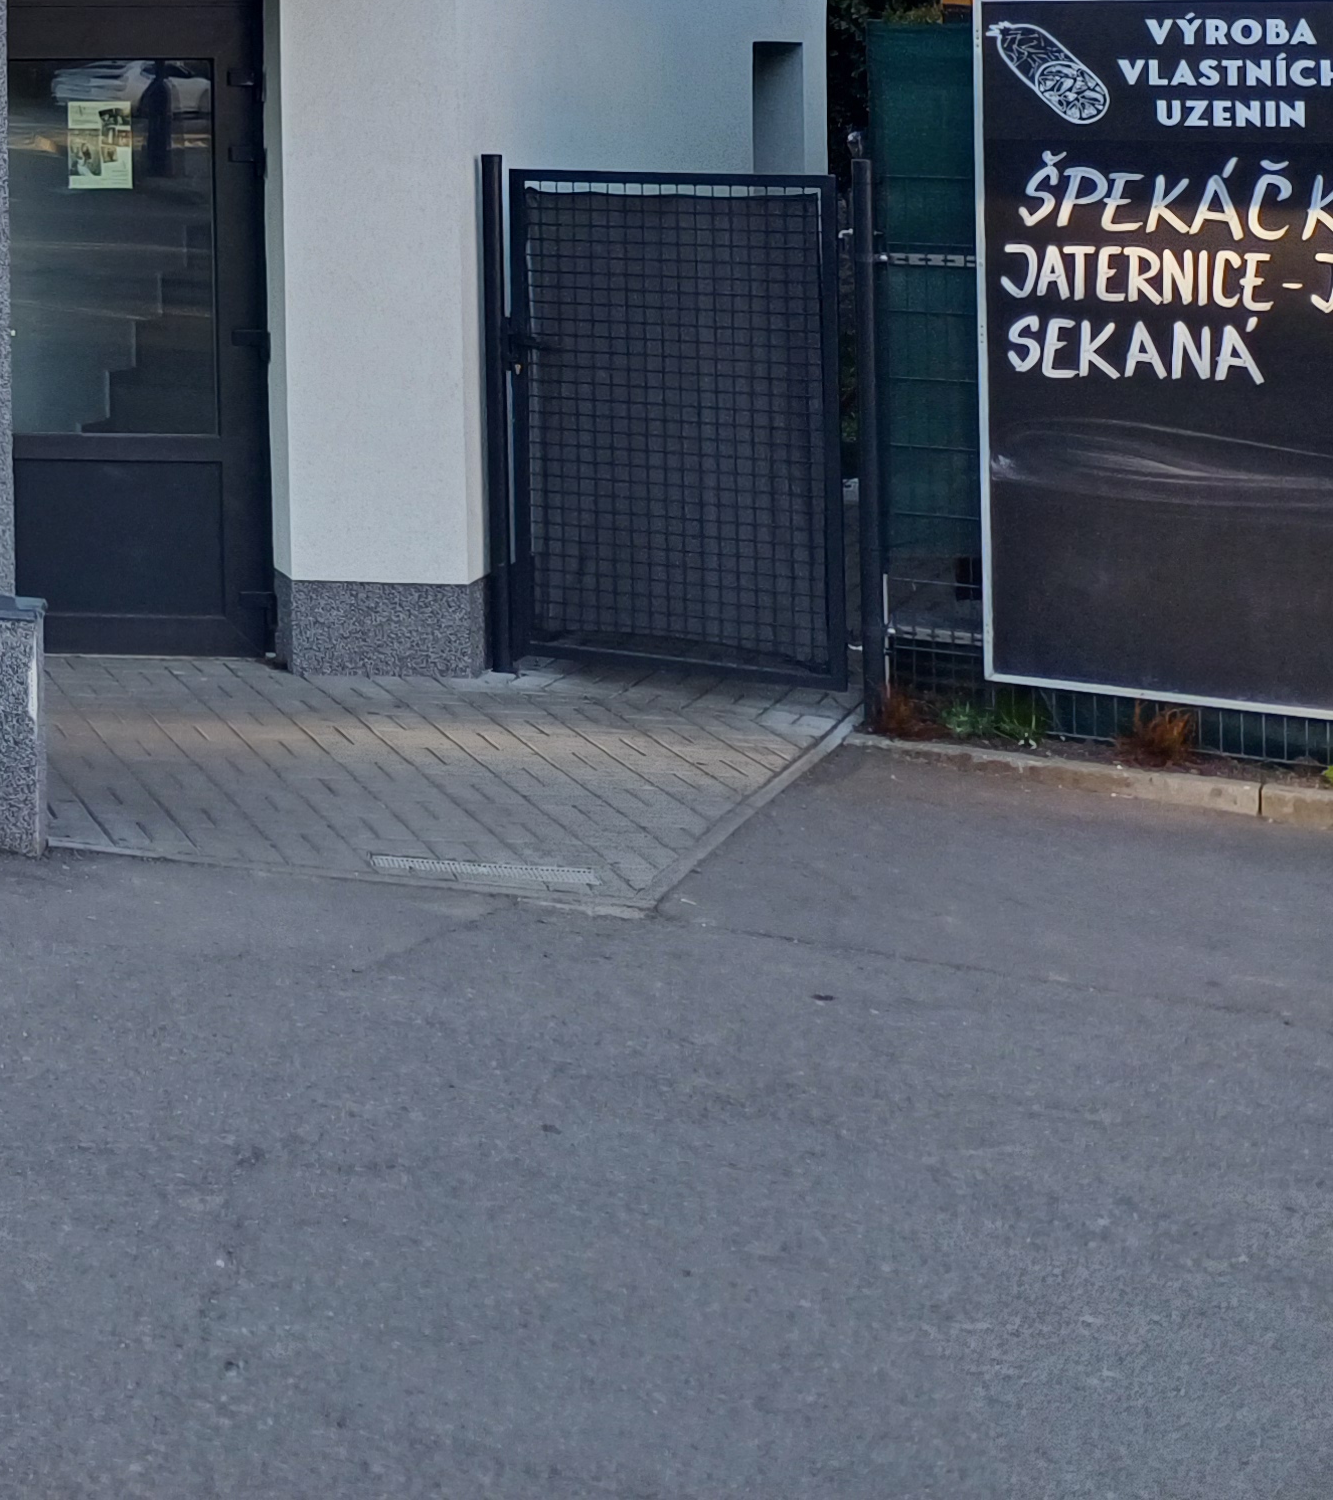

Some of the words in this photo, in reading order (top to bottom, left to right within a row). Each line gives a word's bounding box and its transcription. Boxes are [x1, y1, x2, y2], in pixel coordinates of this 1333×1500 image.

[1145, 12, 1317, 45] VÝROBA
[1156, 100, 1306, 127] UZENIN
[1000, 244, 1274, 311] JATERNICE
[1007, 315, 1264, 385] SEKANÁ
